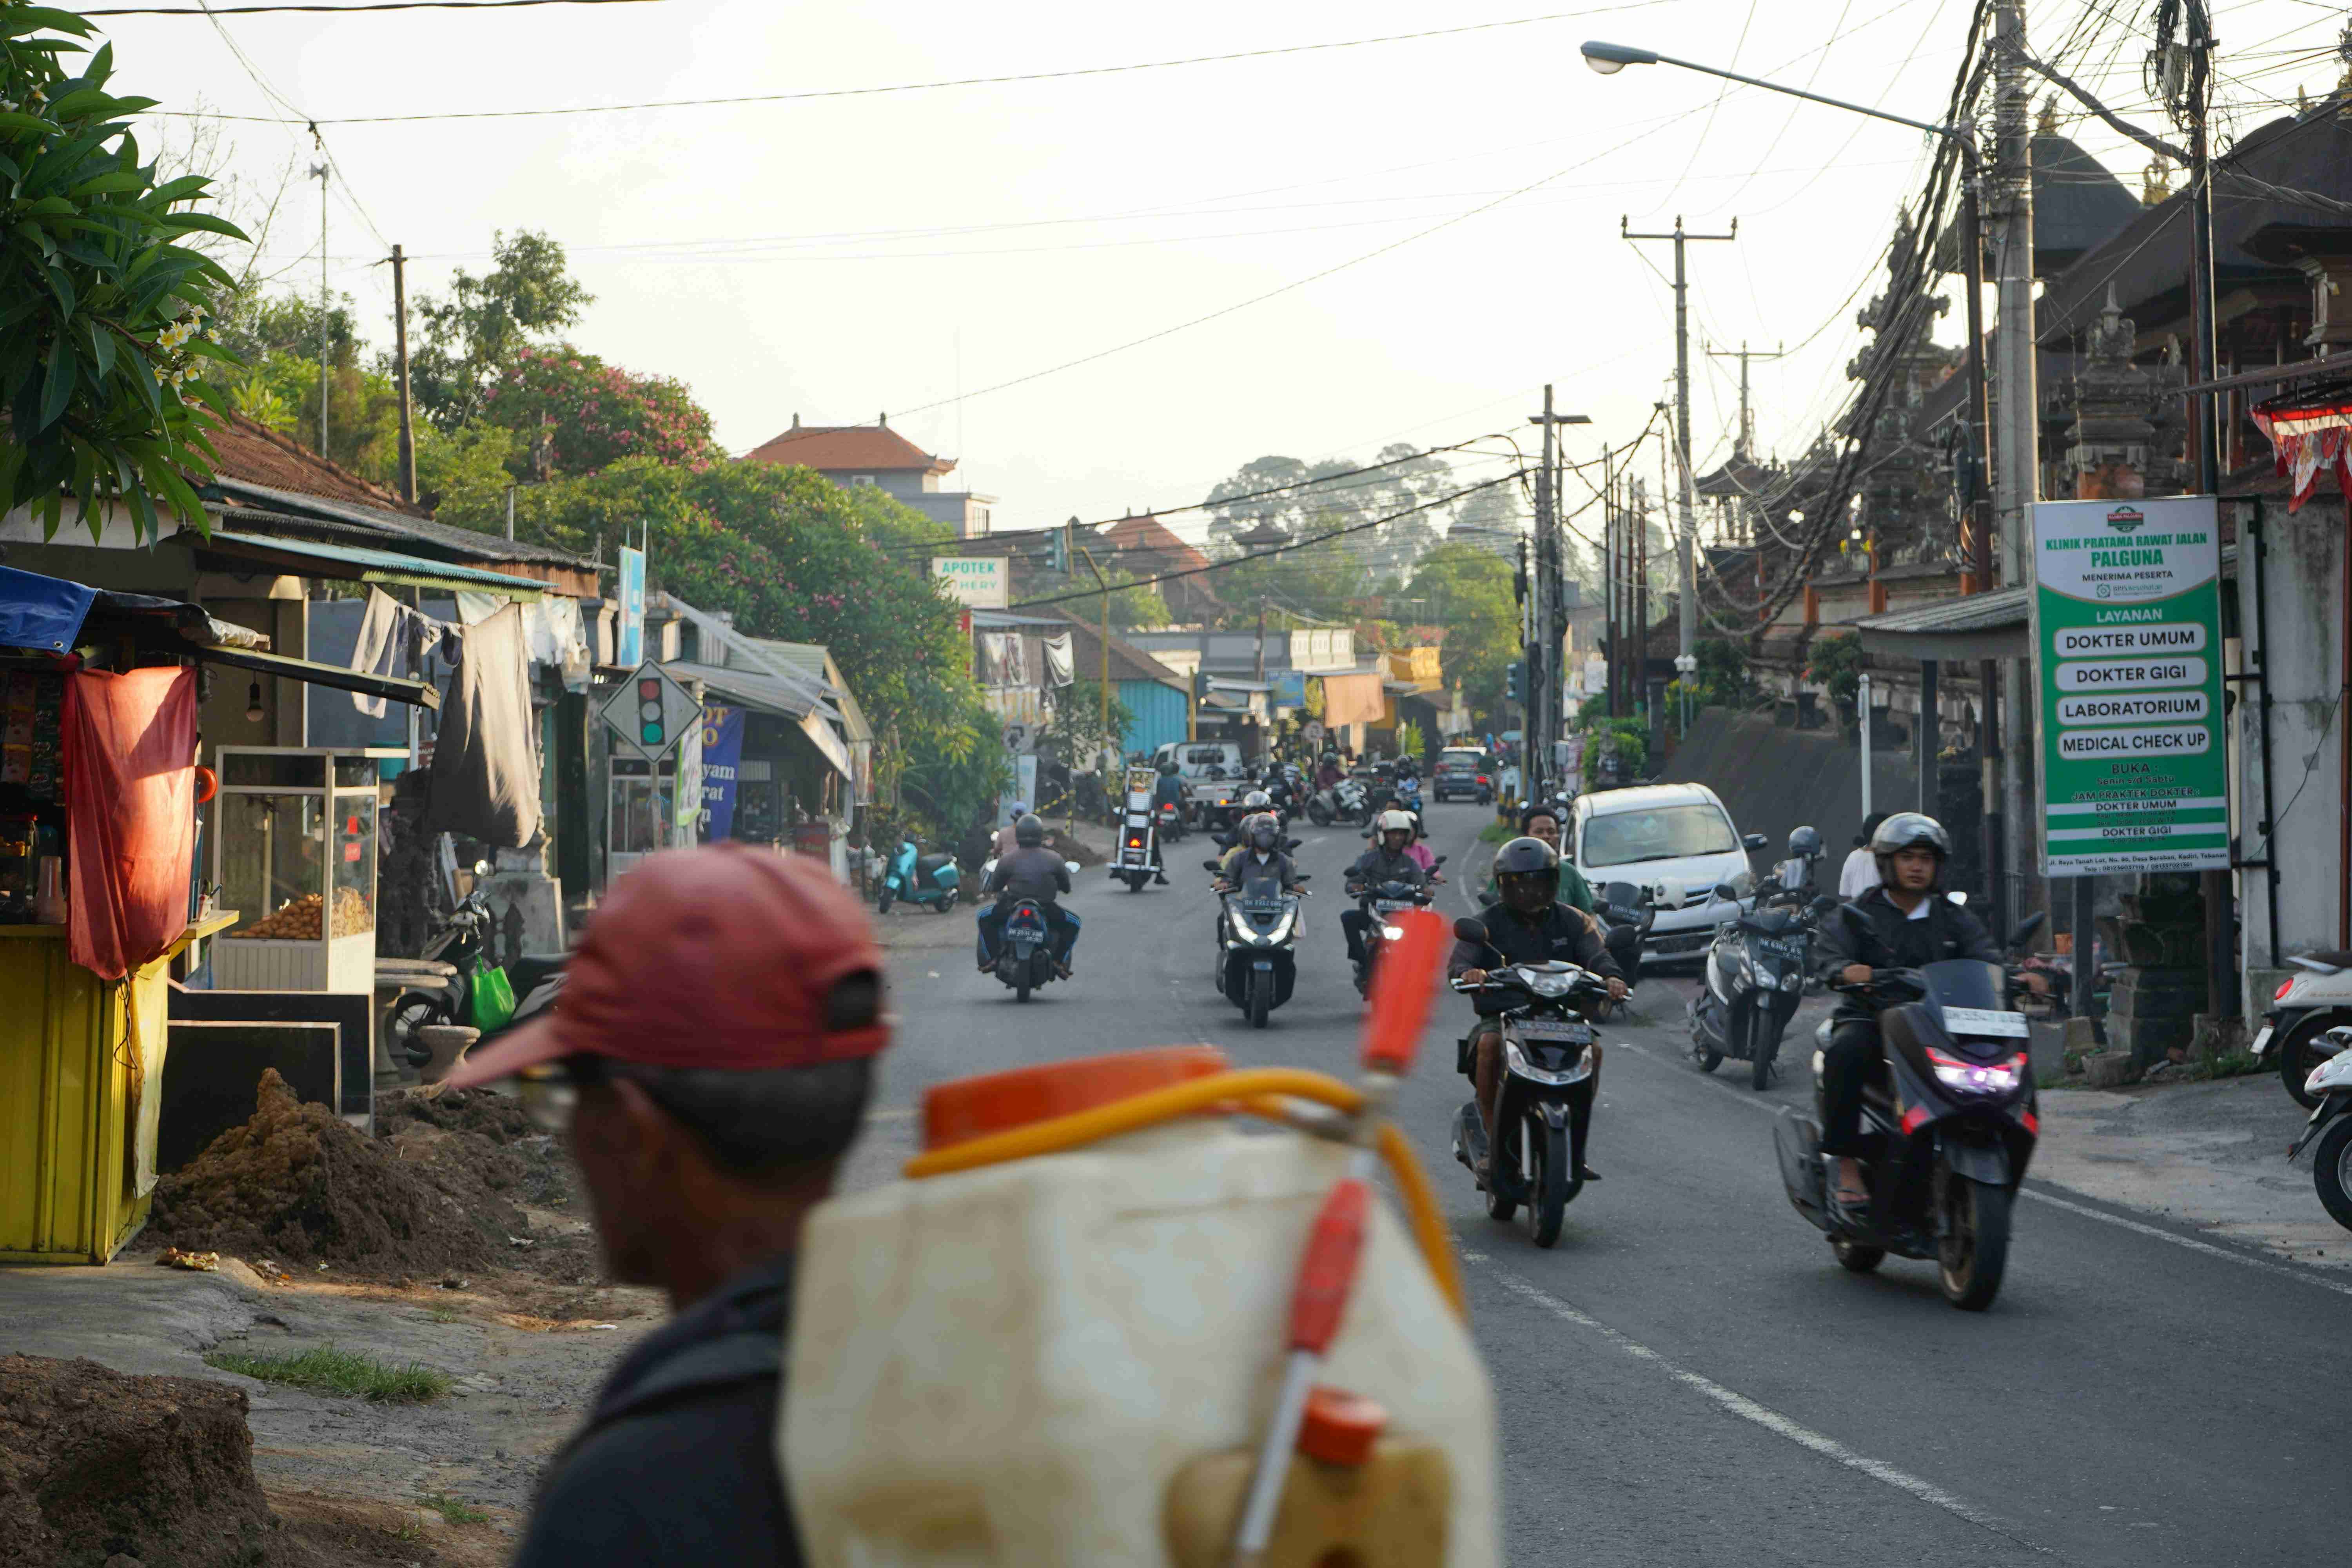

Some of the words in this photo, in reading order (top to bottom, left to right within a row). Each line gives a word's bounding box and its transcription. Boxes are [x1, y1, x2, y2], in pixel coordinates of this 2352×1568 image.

[2046, 538, 2080, 550] KLINIK
[2083, 536, 2133, 548] PRATAMA
[2136, 534, 2172, 546] RAWAT
[2176, 533, 2207, 544] JALAN
[2091, 549, 2163, 568] PALGUNA
[942, 561, 996, 574] APOTEK
[2082, 573, 2132, 582] MENERIMA
[2135, 570, 2173, 579] PESERTA
[2096, 608, 2162, 622] LAYANAN
[2066, 633, 2134, 648] DOKTER
[2140, 631, 2194, 646] UMUM
[2076, 668, 2145, 682] DOKTER
[2150, 665, 2186, 679] GIGI
[2065, 699, 2200, 717] LABORATORIUM
[2063, 737, 2129, 752] MEDICAL
[2132, 733, 2183, 748] CHECK
[2188, 733, 2205, 746] UP
[702, 764, 735, 781] yam
[2112, 763, 2150, 774] BUKA
[702, 785, 724, 802] rat
[2073, 791, 2095, 800] JAM
[2099, 789, 2146, 799] PRAKTEK
[2151, 787, 2192, 797] DOKTER
[2096, 801, 2138, 811] DOKTER
[2142, 799, 2177, 809] UMUM
[2103, 828, 2145, 837] DOKTER
[2148, 826, 2171, 835] GIGI
